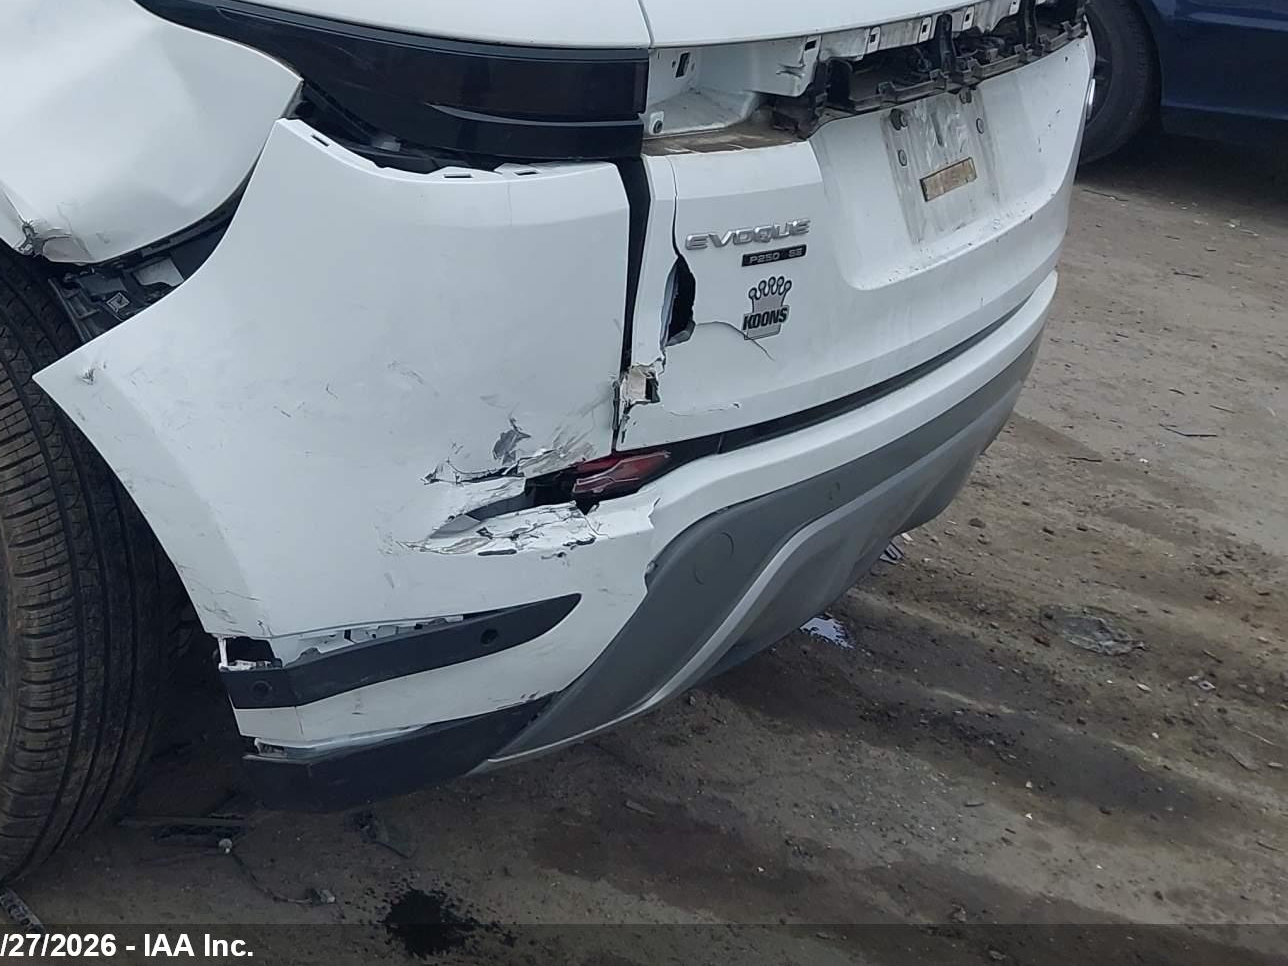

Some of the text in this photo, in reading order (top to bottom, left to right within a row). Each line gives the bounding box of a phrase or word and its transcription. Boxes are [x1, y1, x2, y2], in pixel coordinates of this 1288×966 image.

[685, 218, 811, 250] EVOQUE
[748, 247, 804, 265] P250 SE
[742, 306, 789, 331] KOONS
